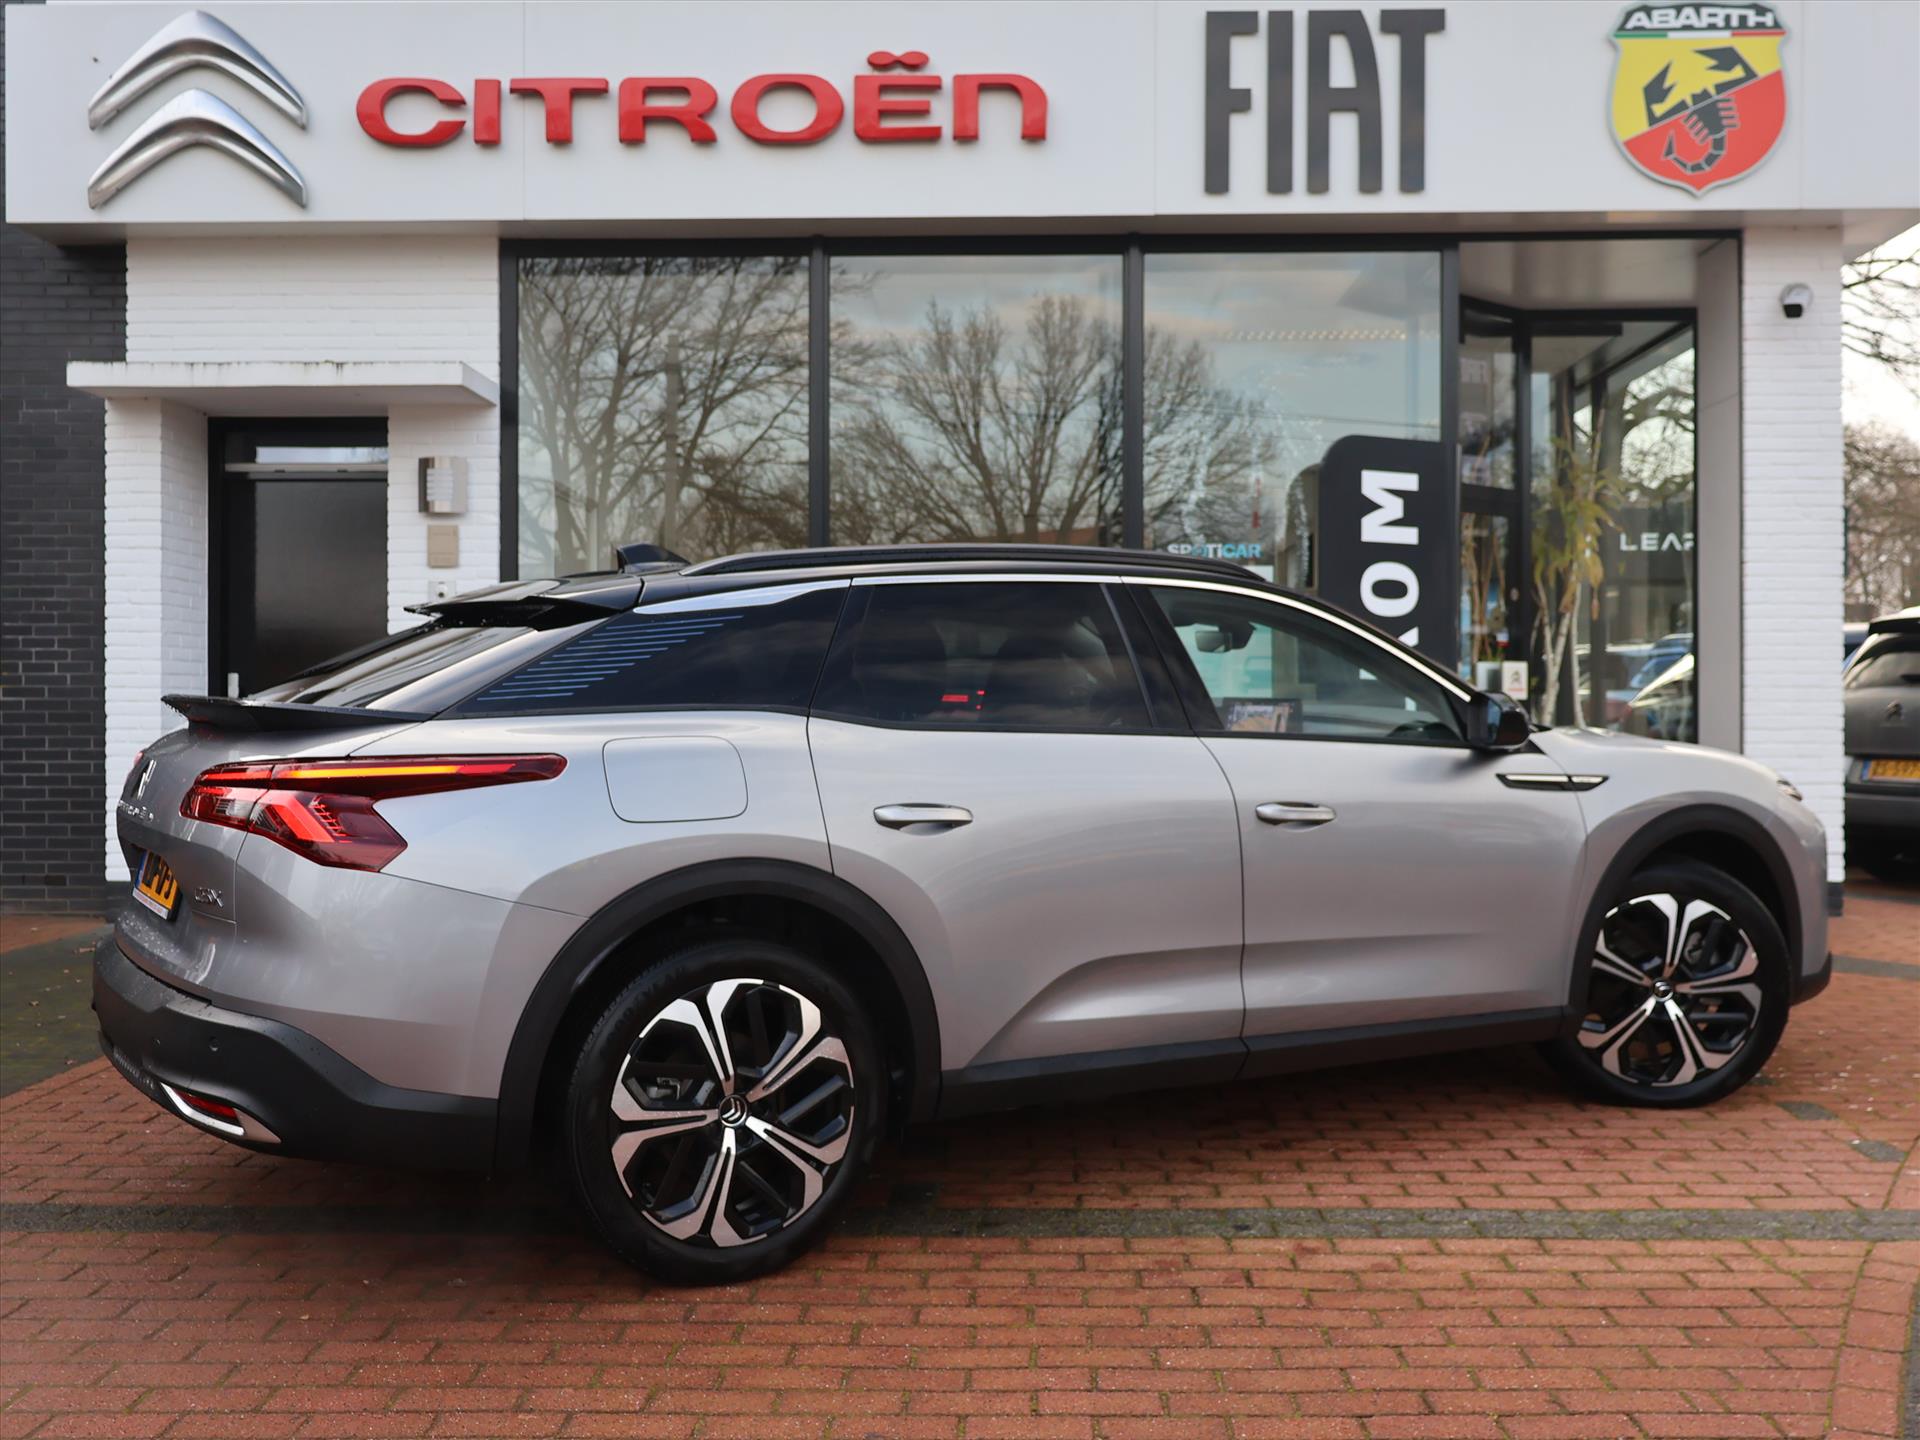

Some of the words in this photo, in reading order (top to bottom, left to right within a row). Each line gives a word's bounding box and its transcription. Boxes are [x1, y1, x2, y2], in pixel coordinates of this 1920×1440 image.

[1204, 9, 1446, 194] FIAT
[1625, 6, 1775, 29] ABARTH
[1359, 469, 1420, 648] OM
